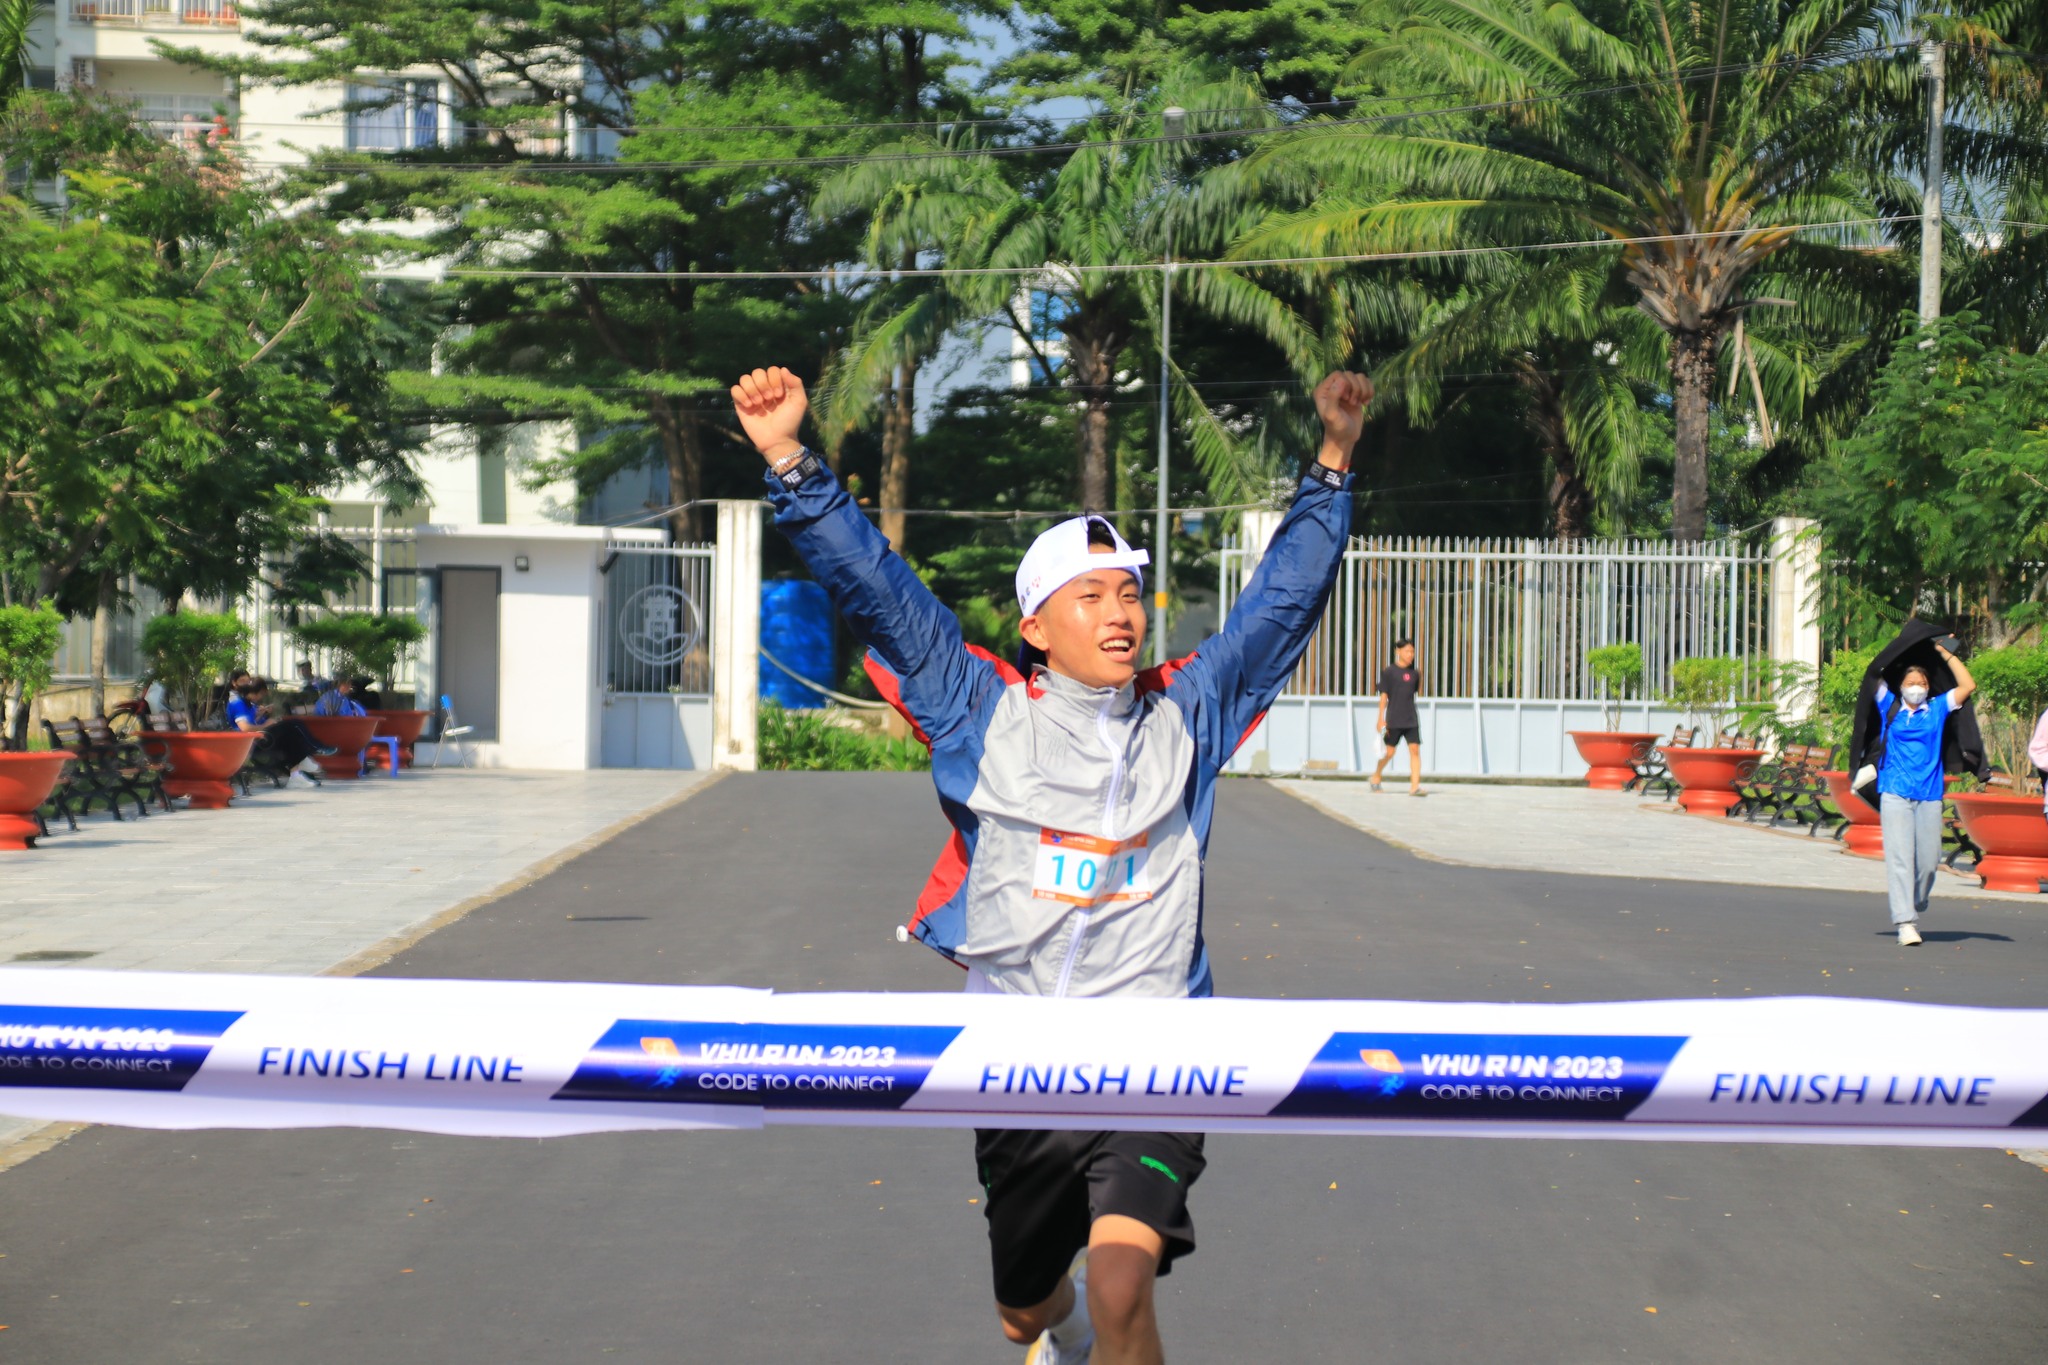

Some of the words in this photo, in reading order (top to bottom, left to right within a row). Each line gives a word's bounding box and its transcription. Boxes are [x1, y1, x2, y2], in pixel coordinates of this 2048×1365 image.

[101, 1027, 175, 1052] 2023
[38, 1055, 67, 1070] TO
[71, 1057, 174, 1072] CONNECT
[257, 1046, 410, 1079] FINISH
[424, 1053, 524, 1083] LINE
[699, 1042, 759, 1065] VHU
[828, 1045, 897, 1068] 2023
[1420, 1053, 1481, 1077] VHU
[1553, 1056, 1624, 1079] 2023
[697, 1071, 758, 1091] CODE
[762, 1074, 791, 1092] TO
[794, 1074, 896, 1093] CONNECT
[979, 1062, 1130, 1096] FINISH
[1145, 1064, 1249, 1097] LINE
[1420, 1083, 1482, 1100] CODE
[1486, 1085, 1515, 1100] TO
[1518, 1085, 1624, 1102] CONNECT
[1709, 1073, 1871, 1105] FINISH
[1883, 1076, 1994, 1107] LINE
